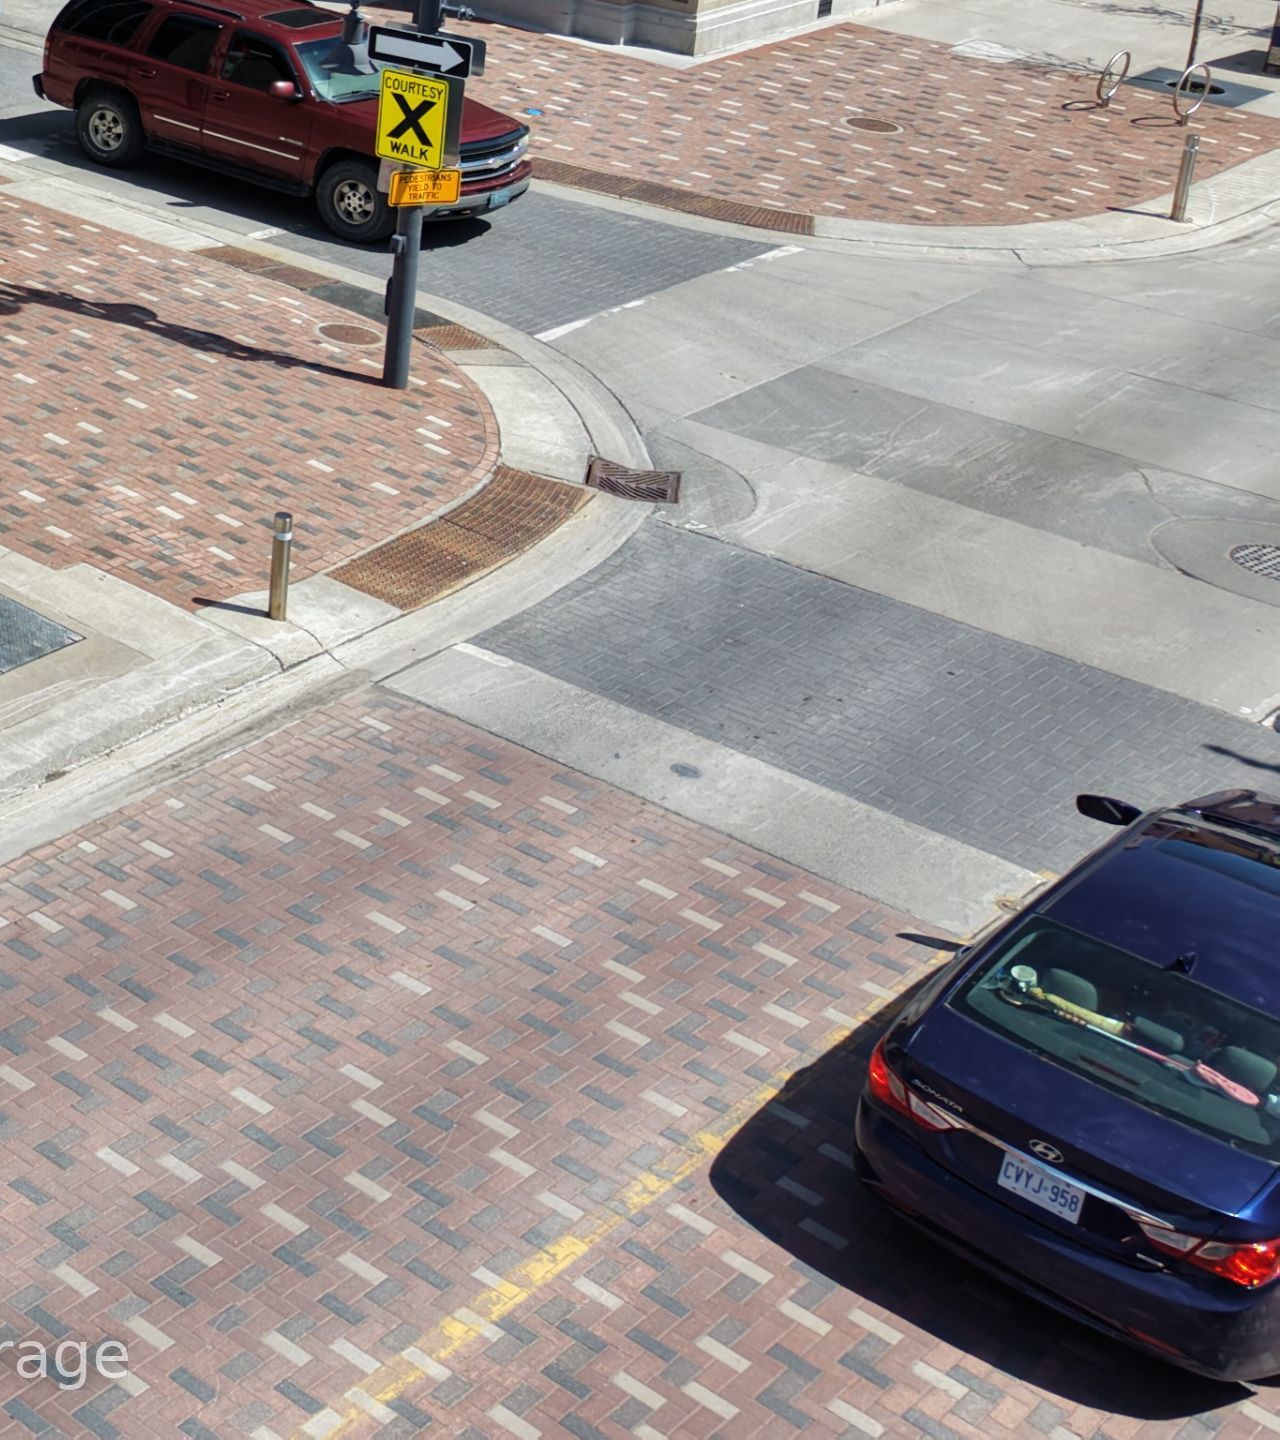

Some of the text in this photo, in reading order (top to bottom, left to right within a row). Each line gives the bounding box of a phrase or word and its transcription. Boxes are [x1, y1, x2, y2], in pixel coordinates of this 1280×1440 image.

[384, 76, 444, 101] COURTESY
[390, 140, 429, 162] WALK
[399, 173, 453, 184] PEDESTRIANS
[407, 181, 443, 193] YIELD TO
[408, 191, 441, 201] TRAFFIC
[1003, 1161, 1080, 1213] CVYJ 958
